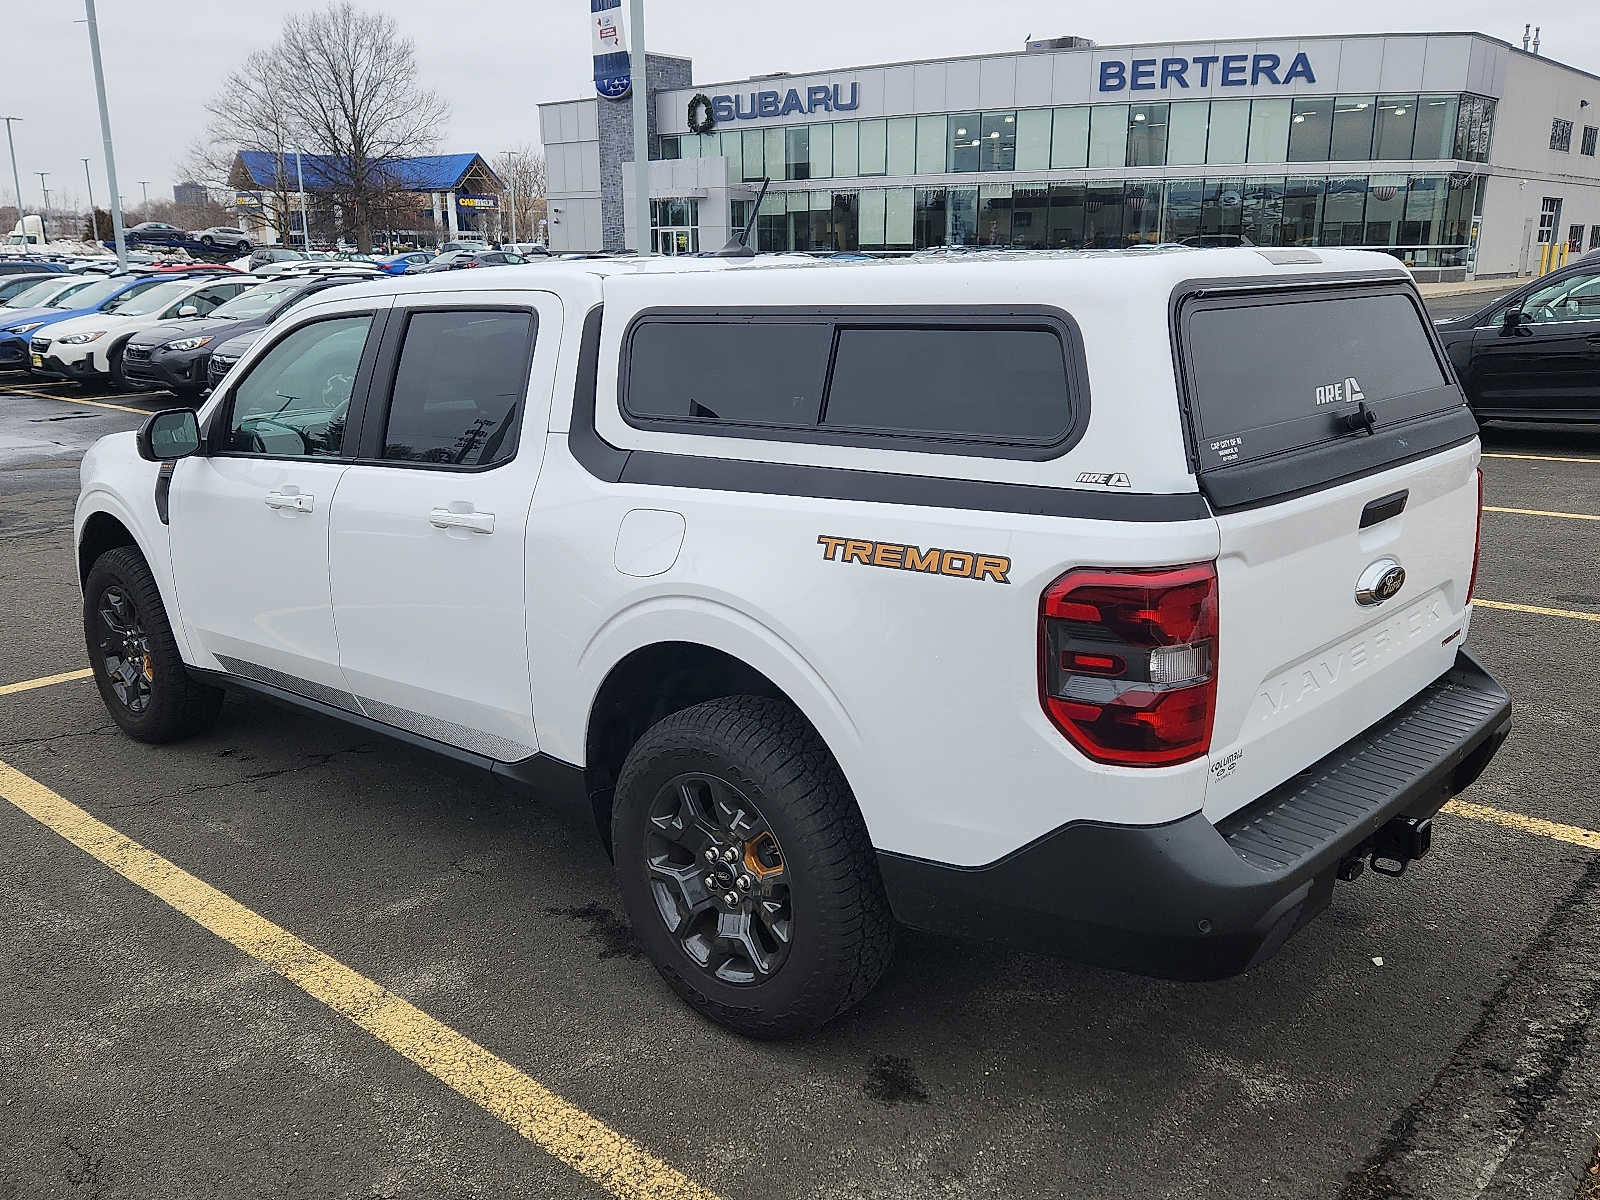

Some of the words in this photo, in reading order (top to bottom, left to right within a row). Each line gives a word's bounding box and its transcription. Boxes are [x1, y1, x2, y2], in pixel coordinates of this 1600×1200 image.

[1099, 52, 1316, 92] BERTERA
[712, 81, 859, 121] SUBARU
[817, 535, 1011, 584] TREMOR
